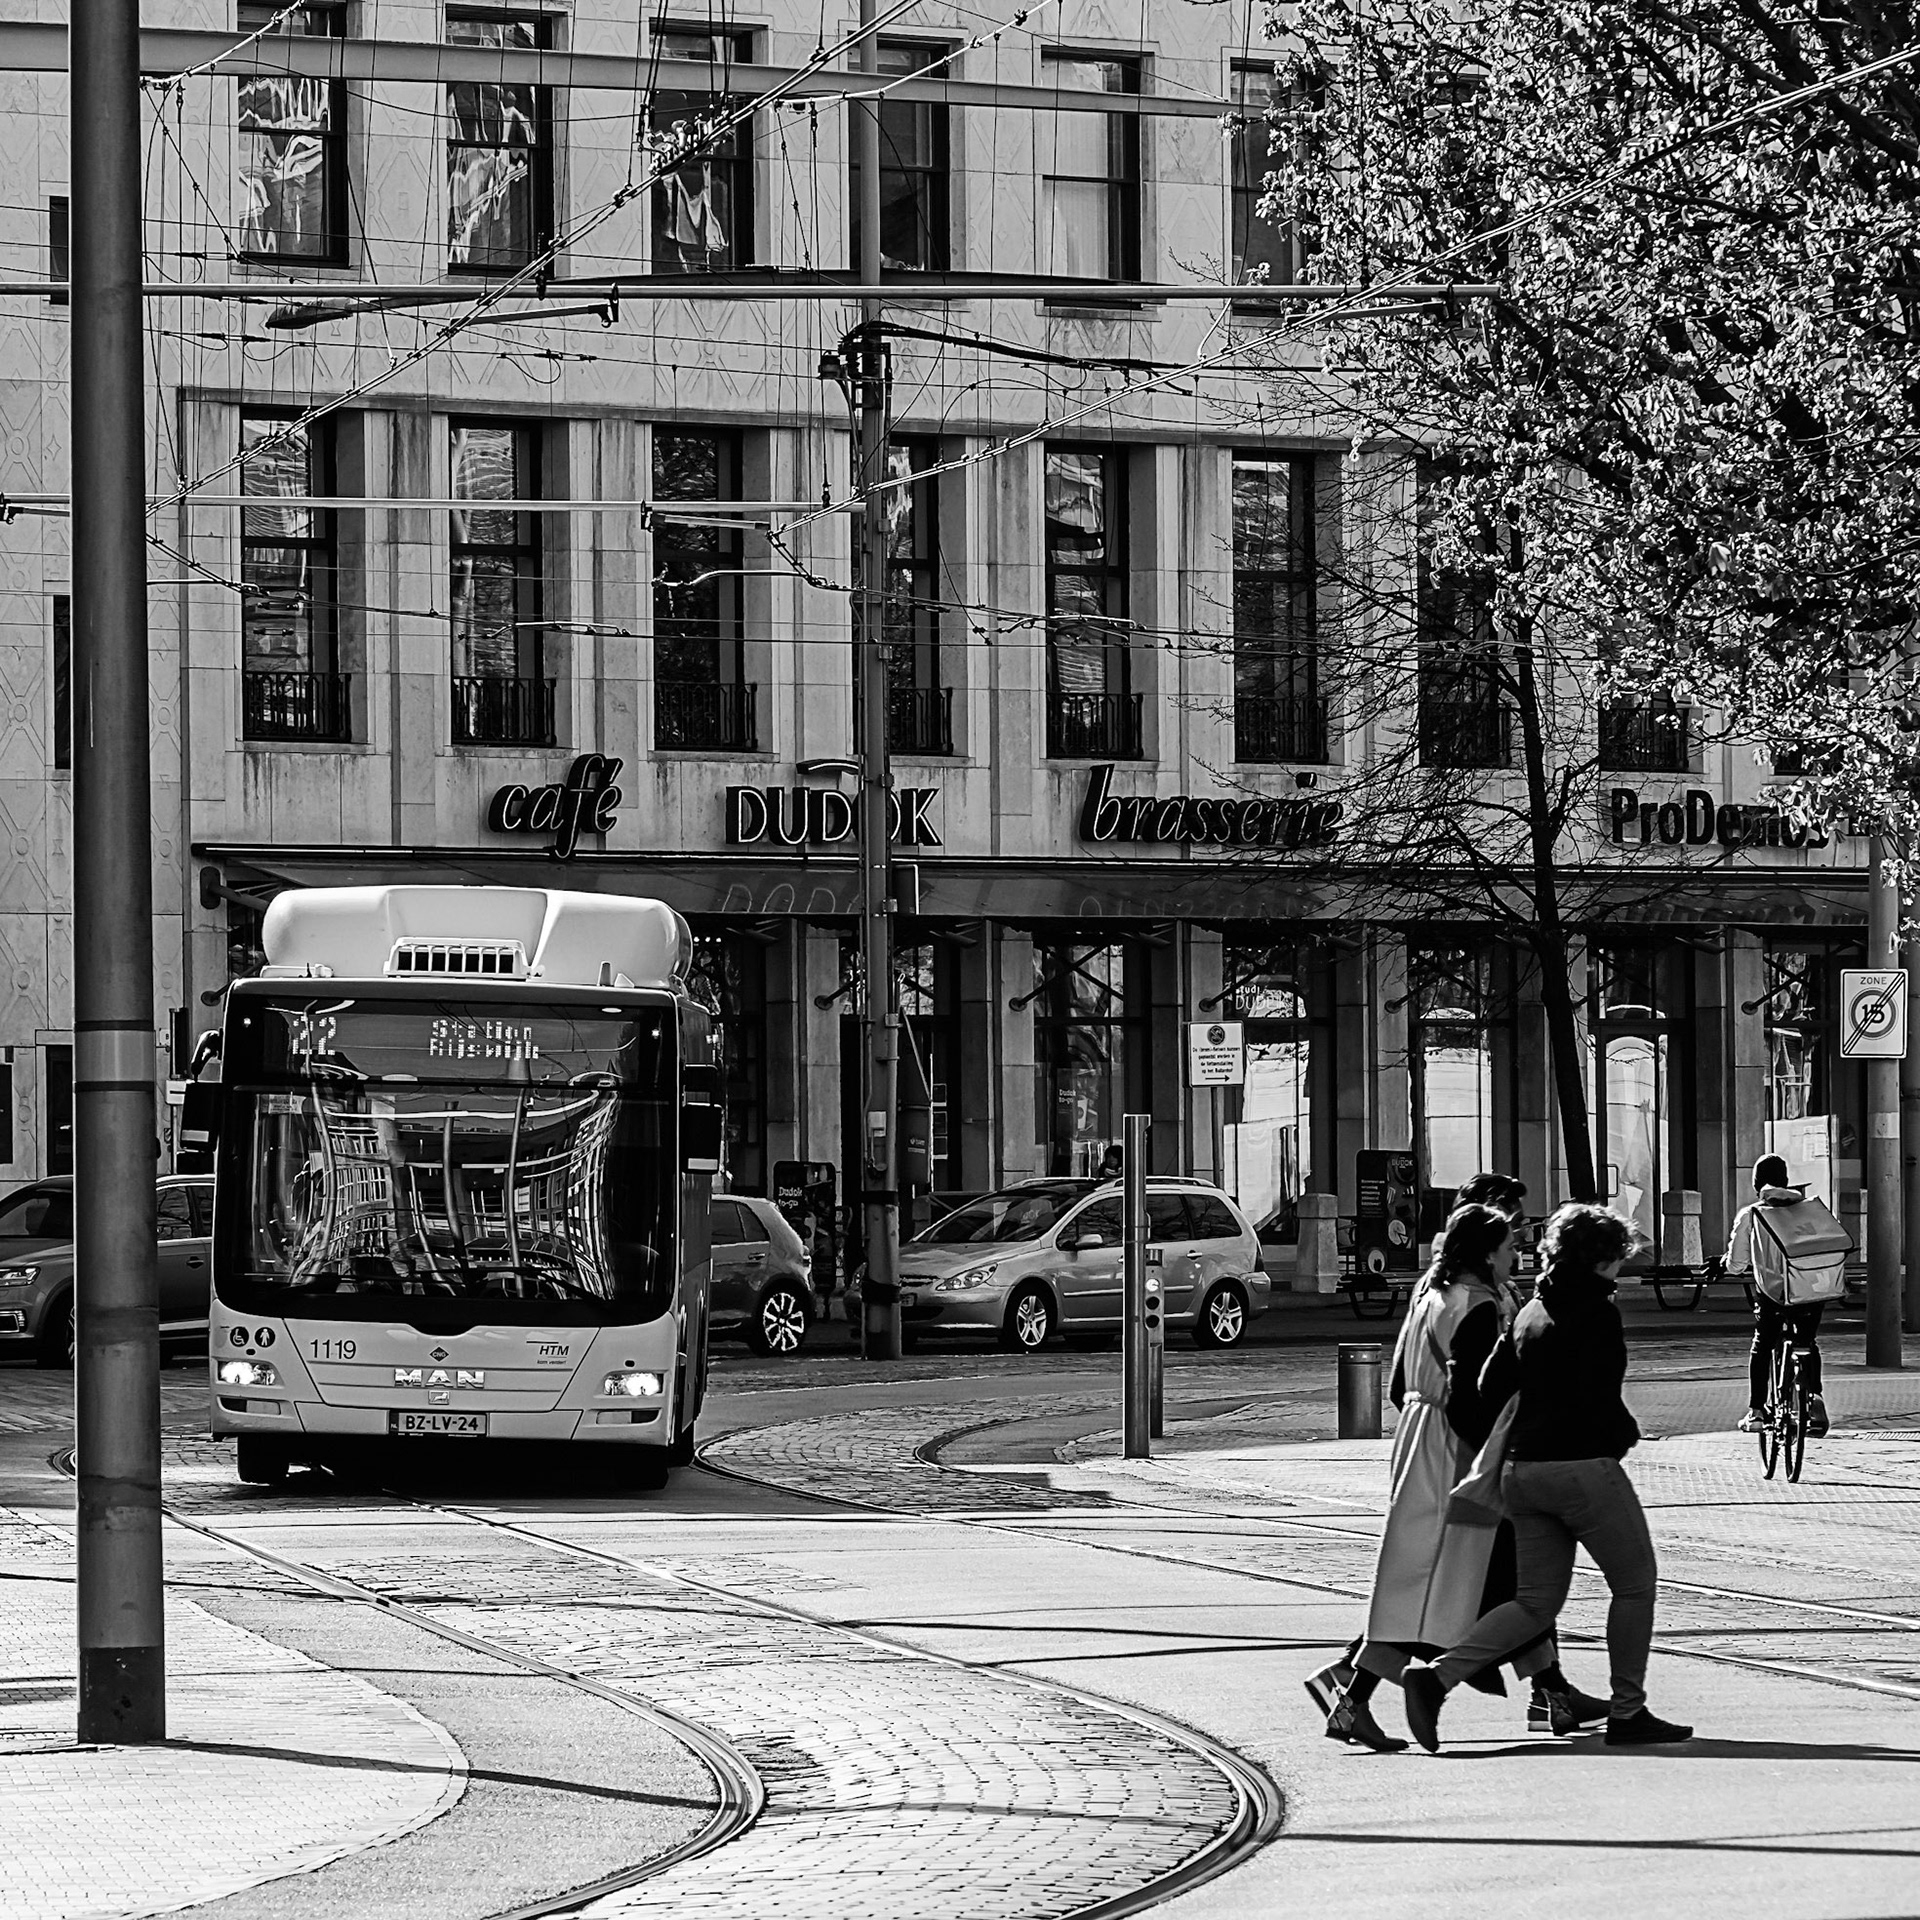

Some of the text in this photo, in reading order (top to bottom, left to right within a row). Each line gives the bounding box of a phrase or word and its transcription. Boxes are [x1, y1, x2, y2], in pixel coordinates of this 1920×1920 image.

[488, 752, 624, 860] café
[1080, 763, 1345, 844] brasserie
[1860, 976, 1887, 985] ZONE
[1861, 1003, 1885, 1024] 15
[292, 1015, 337, 1056] 22
[778, 1186, 803, 1197] Dudok
[310, 1339, 357, 1360] 1119
[539, 1345, 570, 1356] HTM
[394, 1367, 486, 1389] MAN
[406, 1415, 478, 1431] BZ-LV-24
